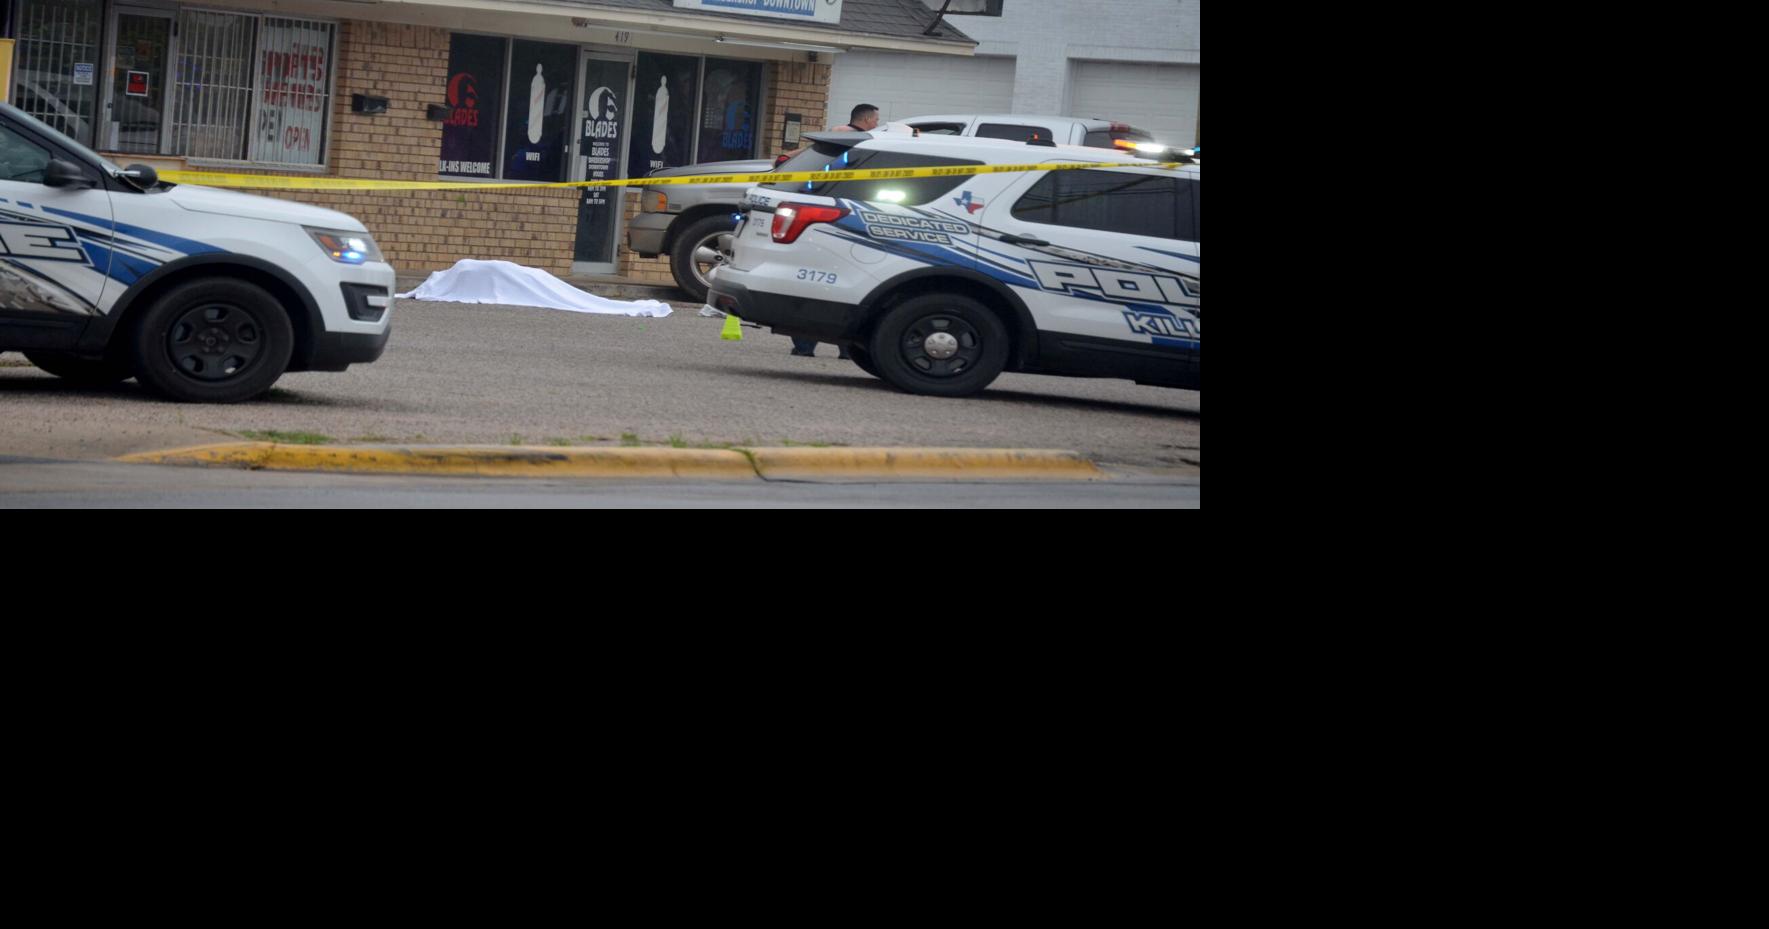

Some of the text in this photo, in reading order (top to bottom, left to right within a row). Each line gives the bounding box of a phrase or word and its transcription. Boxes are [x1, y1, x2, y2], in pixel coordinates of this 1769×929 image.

[443, 108, 480, 129] LADES
[585, 120, 618, 139] BLADES
[525, 151, 540, 162] WIFI
[650, 160, 664, 169] WIFI
[460, 161, 490, 174] WELCOME
[862, 212, 970, 234] DEDICATED
[869, 226, 950, 244] SERVICE
[796, 268, 838, 285] 3179
